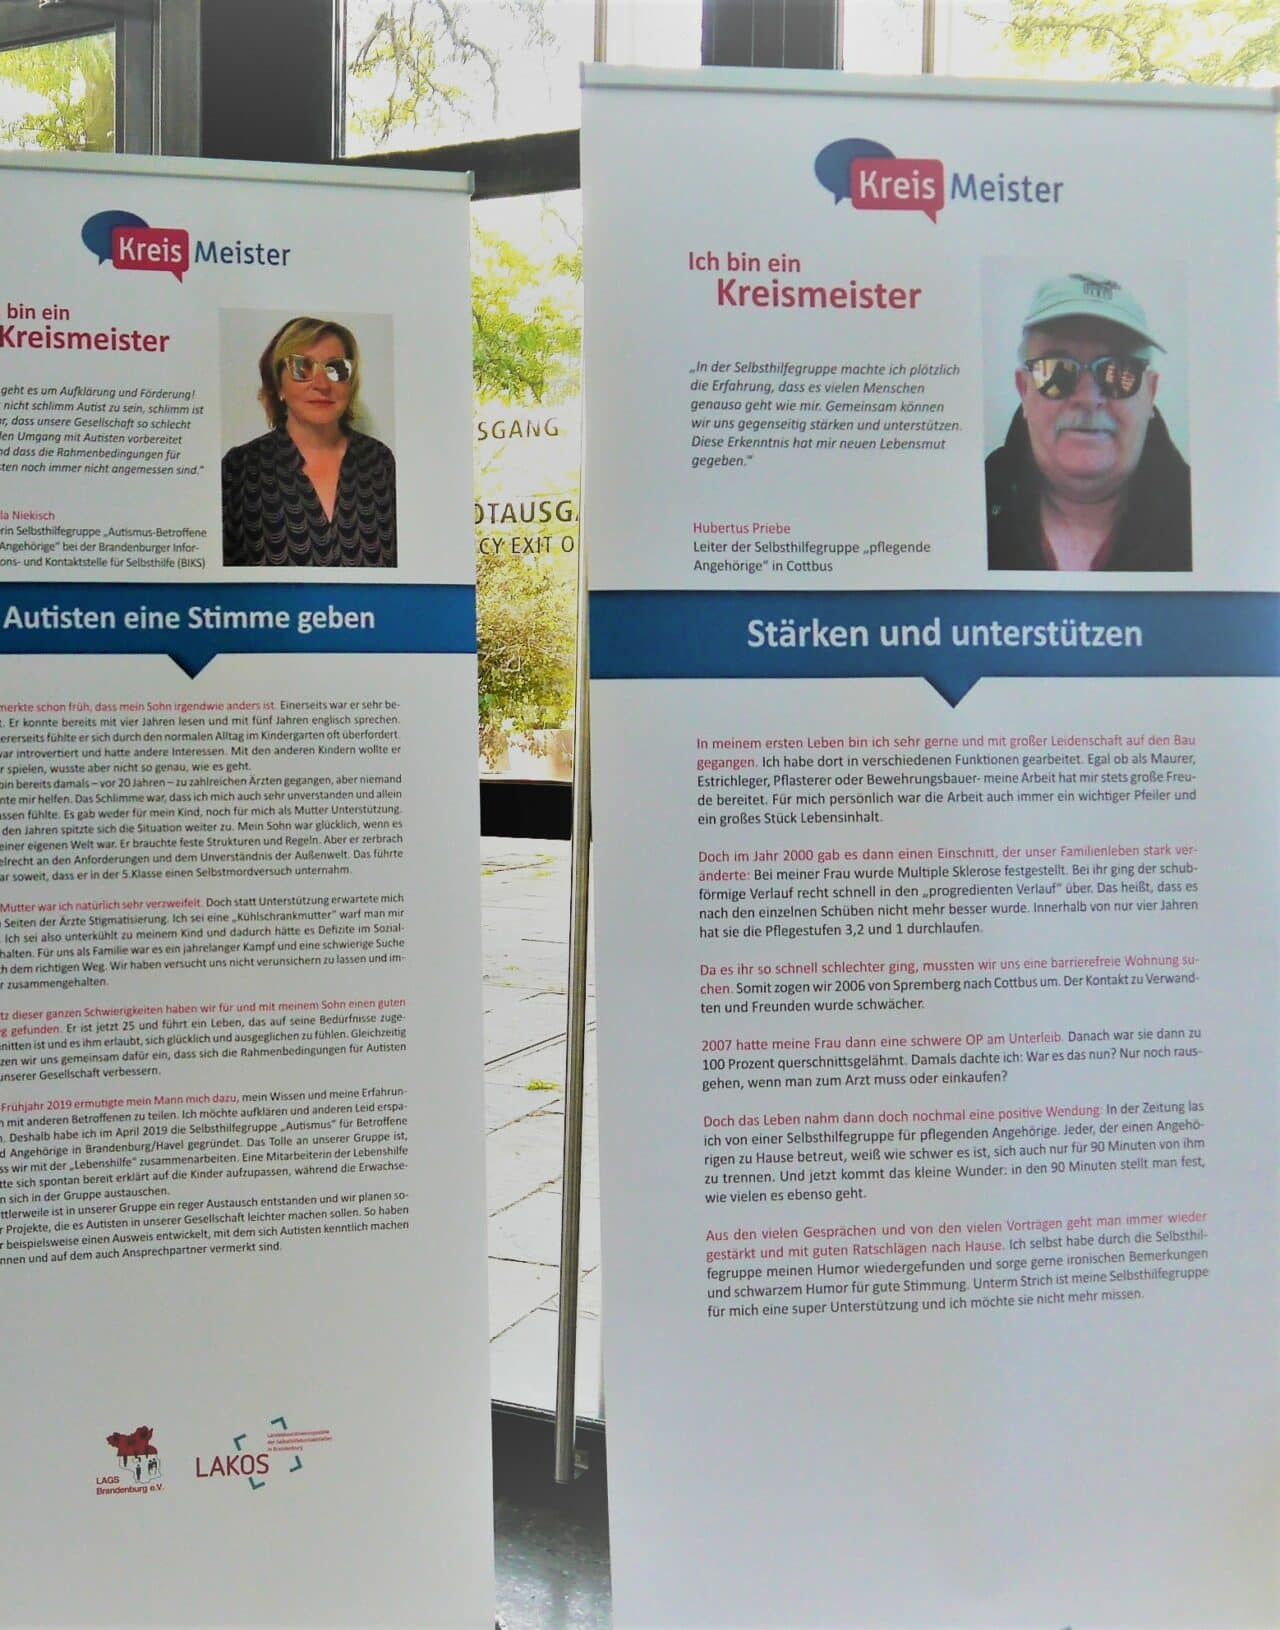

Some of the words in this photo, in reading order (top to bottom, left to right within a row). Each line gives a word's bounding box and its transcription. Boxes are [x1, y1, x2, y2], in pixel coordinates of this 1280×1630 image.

[860, 169, 936, 200] Kreis
[950, 172, 1064, 204] Meister
[120, 236, 182, 263] Kreis
[194, 240, 291, 266] Meister
[688, 250, 720, 272] Ich
[727, 251, 761, 273] bin
[767, 252, 801, 273] ein
[717, 278, 922, 309] Kreismeister
[7, 302, 36, 320] bin
[42, 304, 70, 320] ein
[710, 360, 732, 373] der
[734, 361, 837, 377] Selbsthilfegruppe
[841, 363, 886, 375] machte
[888, 364, 906, 375] ich
[909, 363, 960, 378] plötzlich
[0, 384, 25, 400] geht
[27, 387, 40, 396] es
[40, 384, 58, 397] um
[59, 386, 116, 400] Aufklärung
[118, 388, 138, 398] und
[140, 388, 196, 402] Förderung!
[690, 379, 710, 392] die
[712, 378, 775, 395] Erfahrung,
[776, 380, 806, 393] dass
[807, 383, 822, 394] es
[823, 381, 860, 394] vielen
[862, 381, 925, 395] Menschen
[690, 400, 742, 413] genauso
[745, 399, 773, 414] geht
[775, 399, 797, 411] wie
[799, 400, 822, 416] mir.
[825, 400, 897, 413] Gemeinsam
[899, 400, 944, 414] können
[477, 419, 559, 441] SGANG
[691, 417, 711, 429] wir
[713, 419, 735, 429] uns
[737, 418, 807, 433] gegenseitig
[809, 418, 854, 431] stärken
[857, 419, 881, 431] und
[883, 420, 961, 432] unterstützen.
[691, 435, 724, 448] Diese
[727, 436, 789, 448] Erkenntnis
[792, 437, 813, 448] hat
[816, 440, 837, 448] mir
[839, 440, 876, 449] neuen
[880, 438, 946, 450] Lebensmut
[12, 510, 55, 521] Niekisch
[16, 524, 101, 539] Selbsthilfegruppe
[691, 520, 750, 536] Hubertus
[751, 522, 792, 535] Priebe
[62, 541, 78, 552] bei
[80, 541, 96, 552] der
[98, 542, 171, 554] Brandenburger
[173, 542, 199, 552] Infor-
[511, 536, 552, 554] EXIT
[691, 539, 728, 553] Leiter
[731, 540, 752, 553] der
[754, 538, 861, 556] Selbsthilfegruppe
[23, 557, 43, 567] und
[45, 557, 108, 567] Kontaktstelle
[110, 557, 124, 567] für
[126, 557, 175, 568] Selbsthilfe
[177, 558, 206, 570] (BIKS)
[772, 560, 783, 572] in
[786, 560, 833, 575] Cottbus
[3, 605, 115, 629] Autisten
[124, 606, 180, 629] eine
[188, 606, 290, 629] Stimme
[297, 606, 375, 634] geben
[748, 618, 868, 647] Stärken
[880, 617, 941, 646] und
[952, 619, 1142, 647] unterstützen
[196, 1453, 269, 1478] LAKOS
[96, 1475, 120, 1485] LAGS
[96, 1485, 148, 1496] Brandenburg
